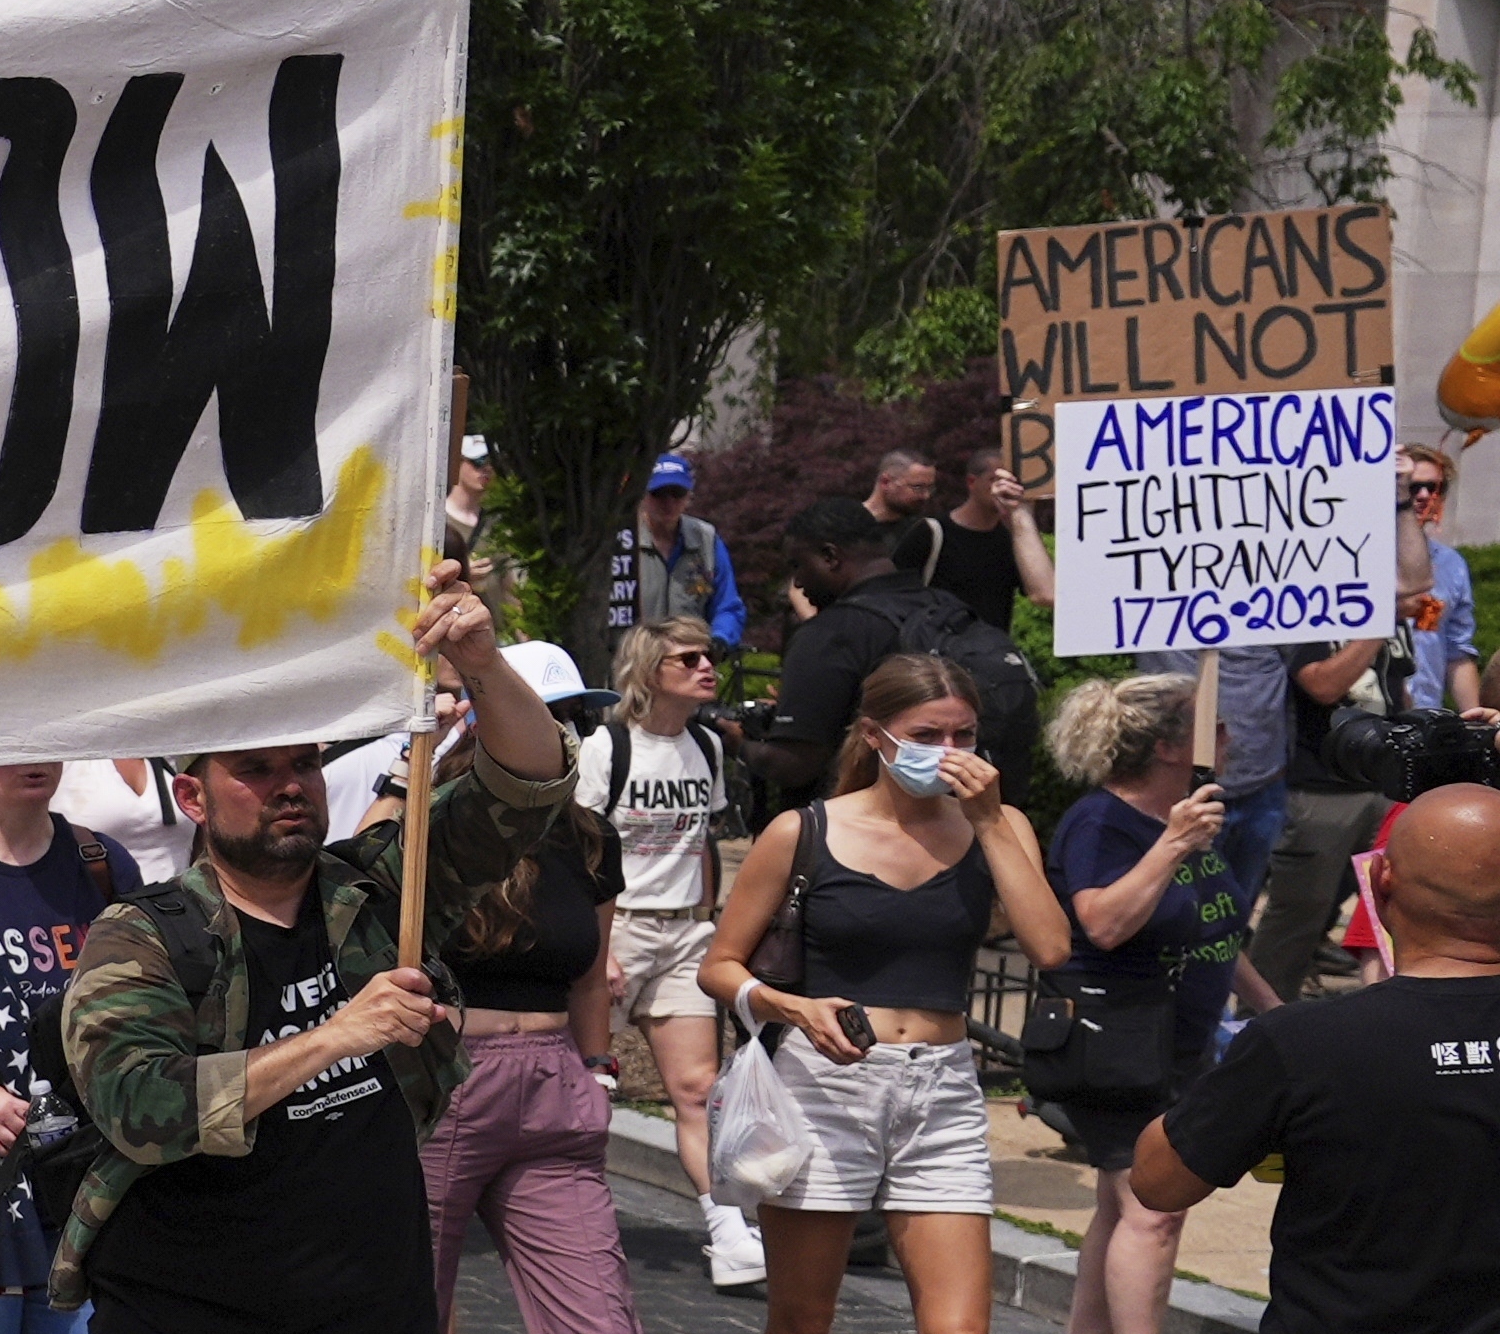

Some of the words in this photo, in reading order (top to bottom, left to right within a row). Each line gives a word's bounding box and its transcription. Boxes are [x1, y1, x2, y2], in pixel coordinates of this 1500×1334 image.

[1000, 207, 1388, 319] AMERICANS
[1002, 316, 1176, 398] WILL
[1194, 299, 1385, 385] NOT
[1086, 392, 1394, 471] AMERICANS
[1076, 465, 1347, 543] FIGHTING
[1105, 533, 1370, 591] TYRANNY
[630, 778, 709, 809] HANDS
